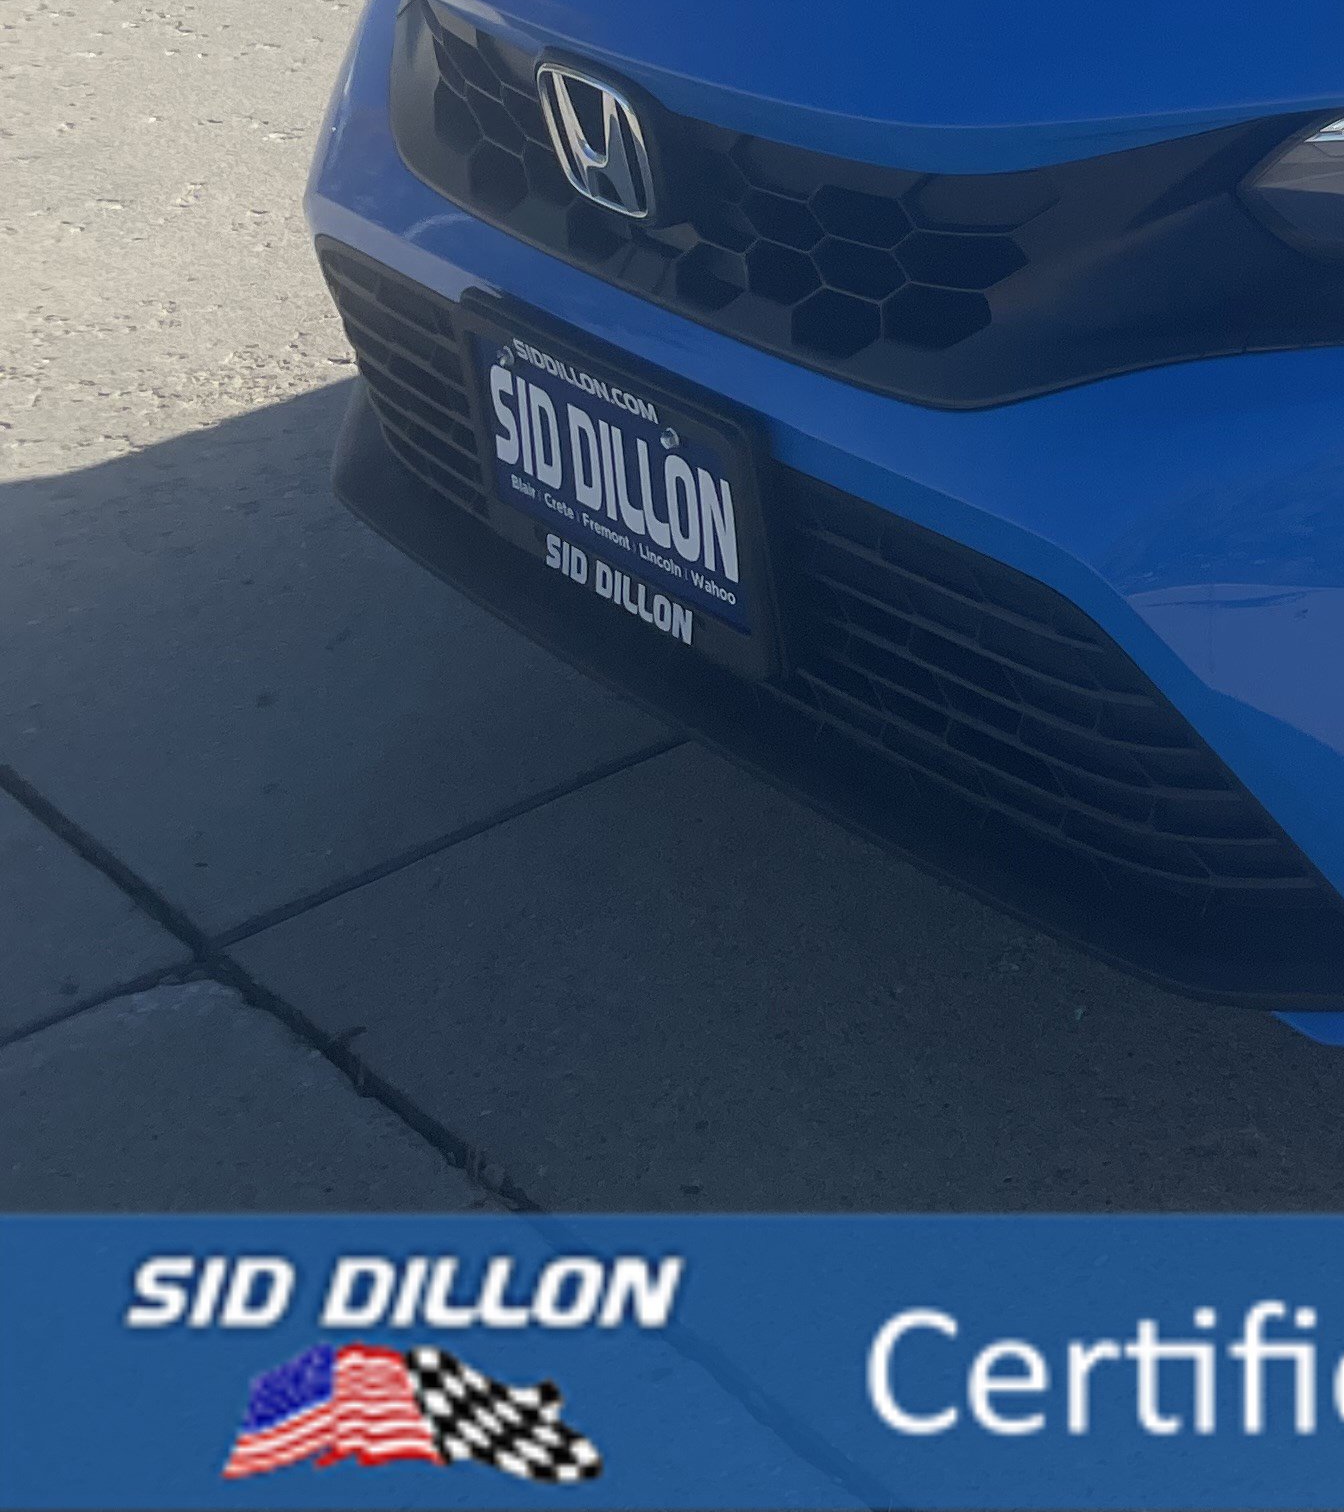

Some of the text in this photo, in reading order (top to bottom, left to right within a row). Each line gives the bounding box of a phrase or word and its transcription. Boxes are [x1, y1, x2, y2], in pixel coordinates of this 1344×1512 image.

[513, 338, 659, 425] SIDDILLON.COM
[490, 364, 739, 584] SID DILLON
[511, 474, 737, 605] Blair Crete Fremont Lincoln Wahoo
[546, 533, 693, 646] SID DILLON
